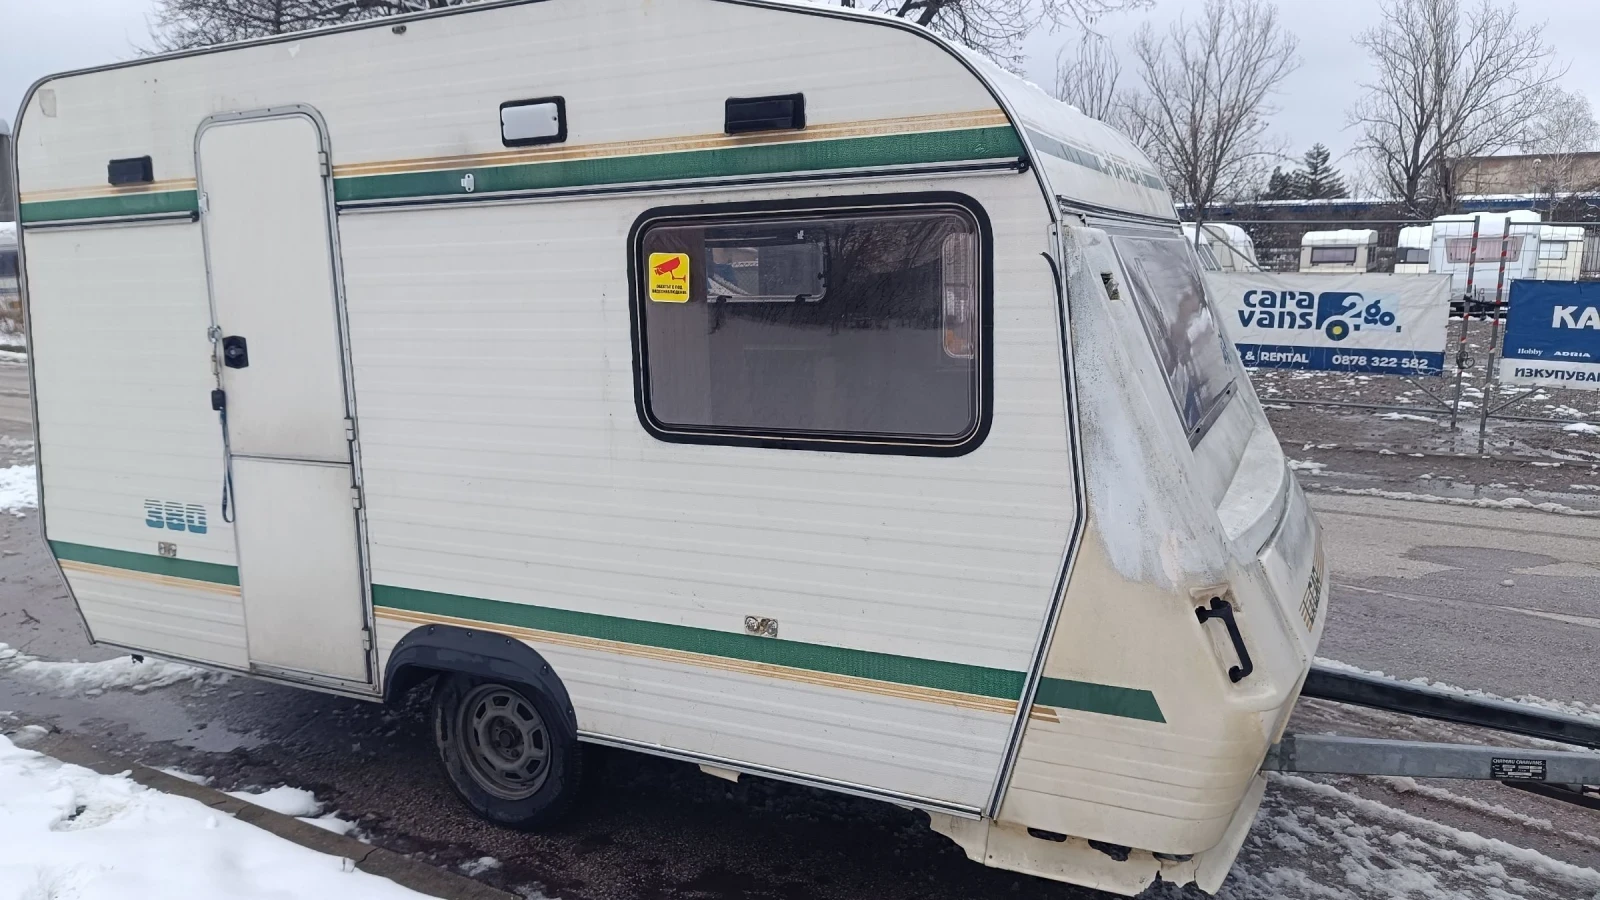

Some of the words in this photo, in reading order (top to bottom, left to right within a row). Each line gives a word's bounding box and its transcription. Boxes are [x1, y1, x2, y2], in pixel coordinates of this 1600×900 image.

[1243, 290, 1315, 309] cara
[1237, 310, 1314, 330] vans
[1245, 351, 1255, 361] &
[1261, 352, 1309, 363] RENTAL
[1517, 348, 1543, 356] Hobby
[1332, 354, 1367, 366] 0878
[1371, 357, 1397, 368] 322
[1401, 358, 1428, 370] 582
[144, 499, 207, 534] 380
